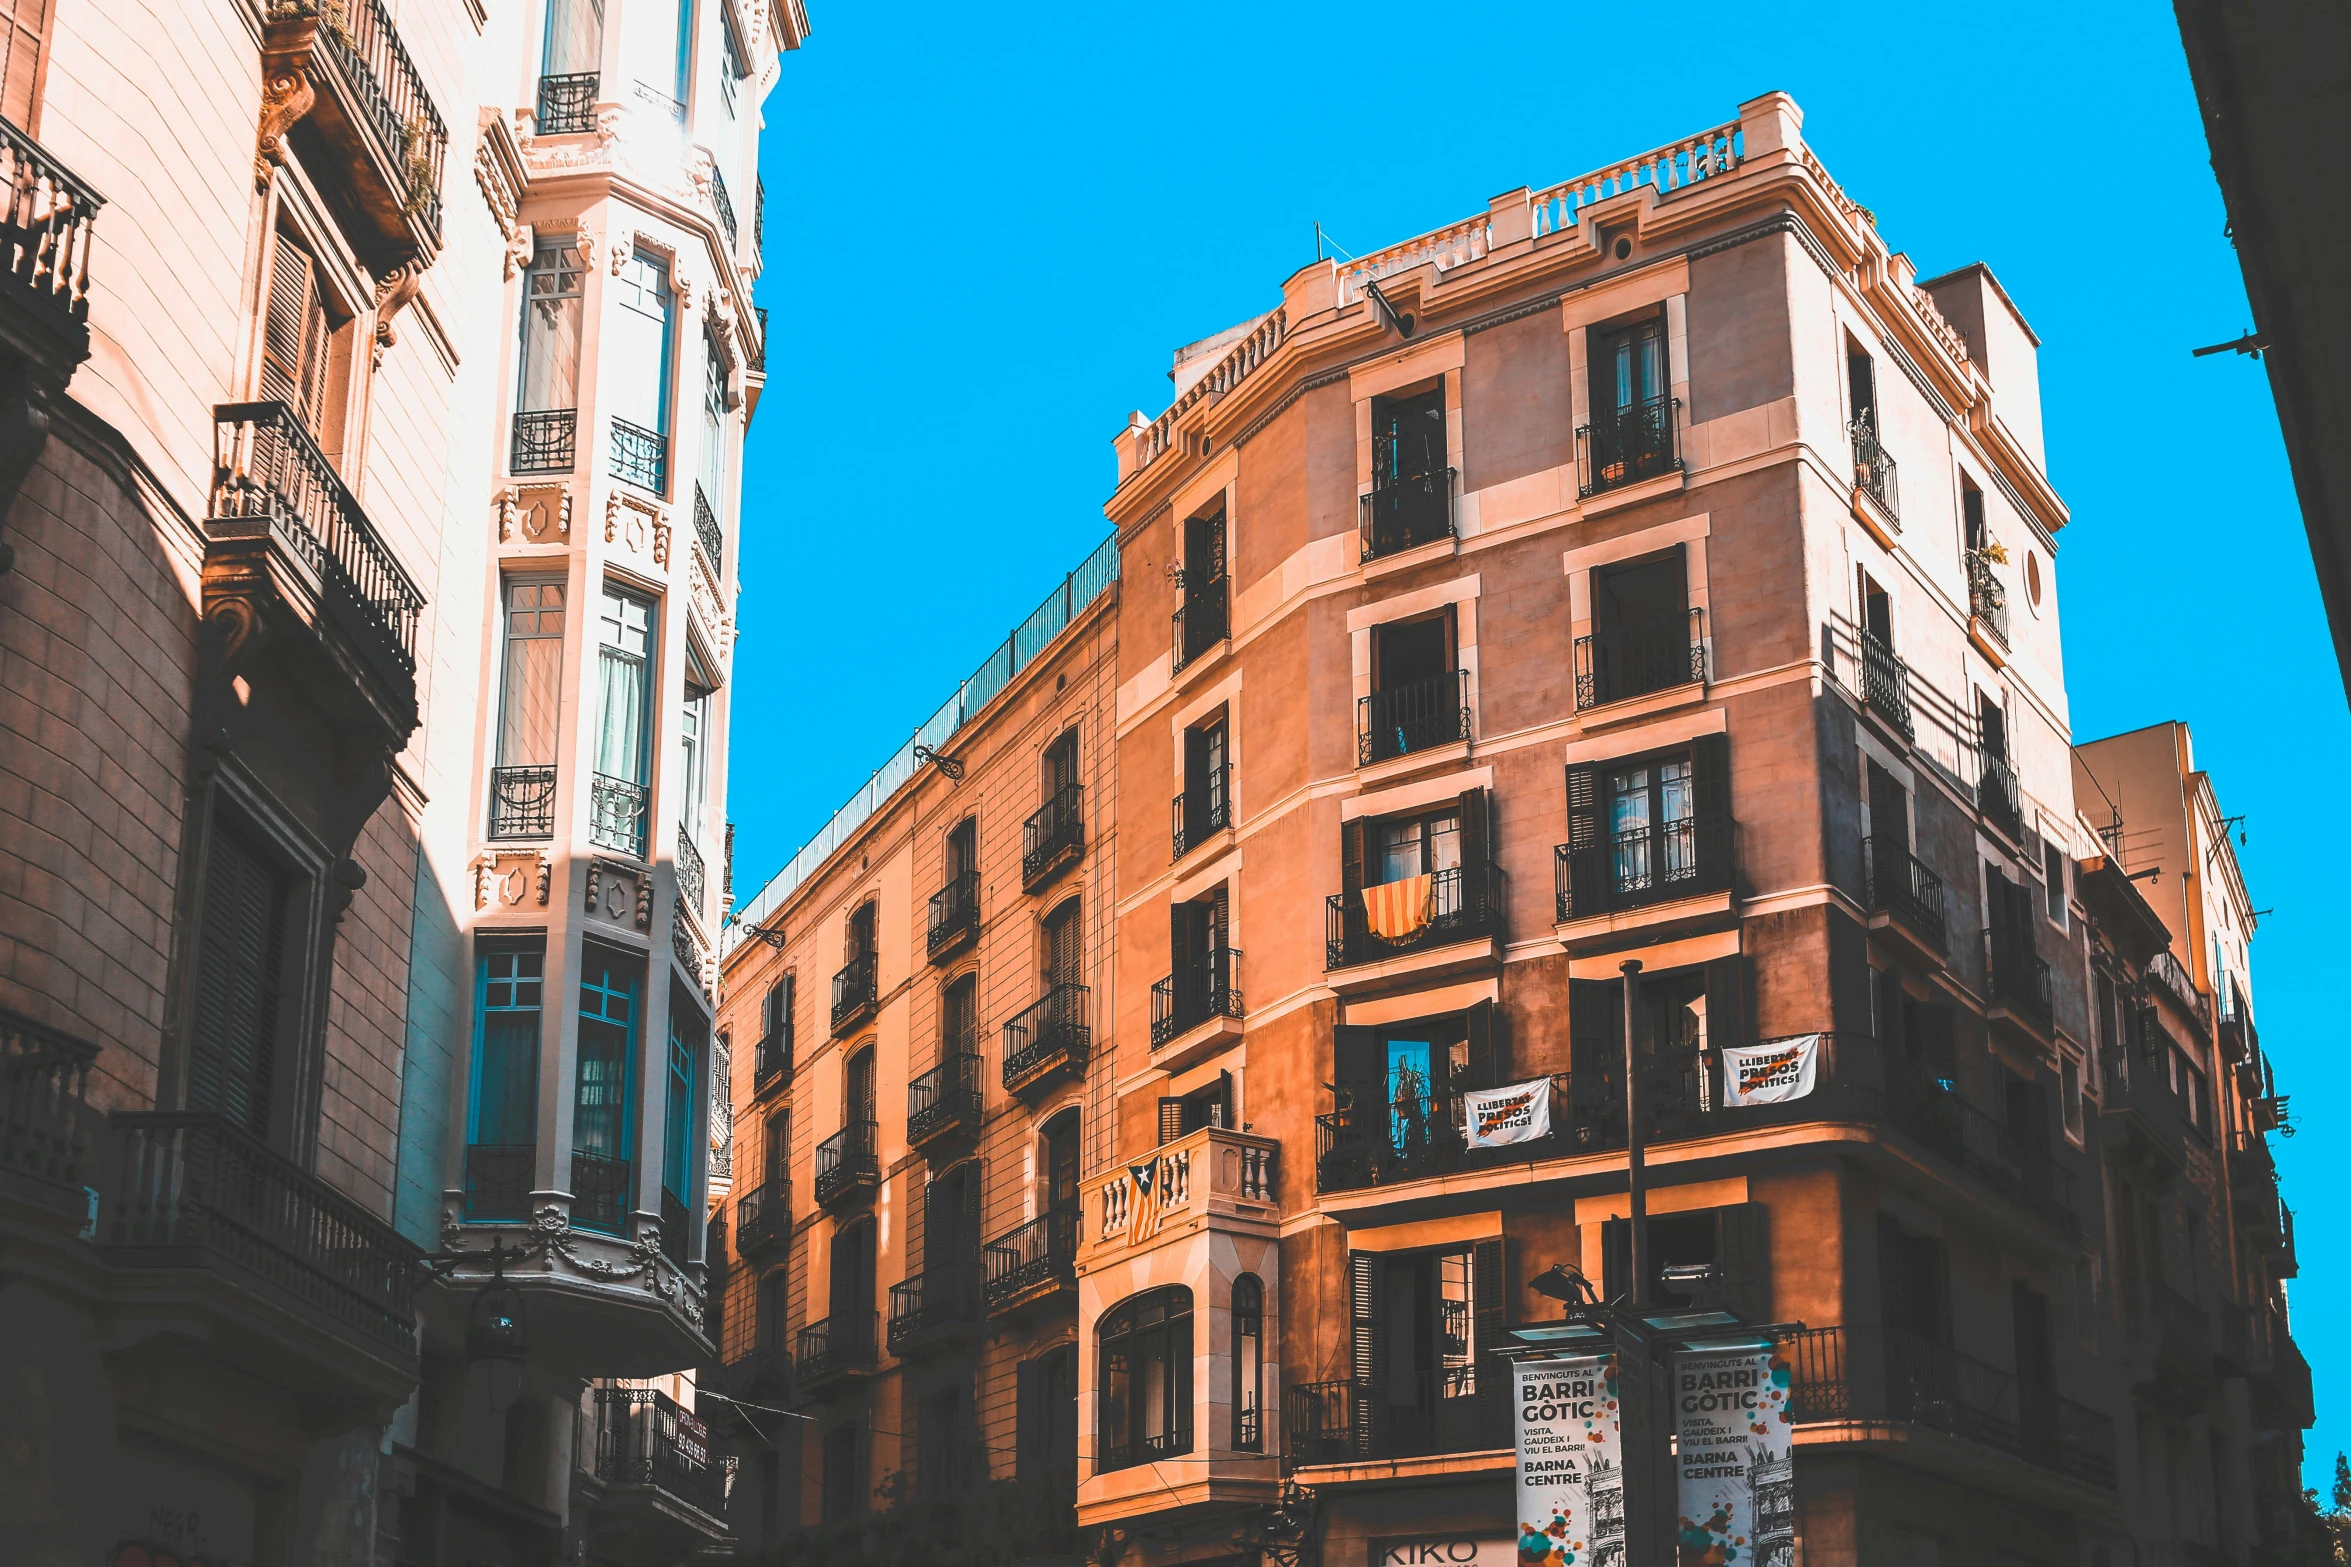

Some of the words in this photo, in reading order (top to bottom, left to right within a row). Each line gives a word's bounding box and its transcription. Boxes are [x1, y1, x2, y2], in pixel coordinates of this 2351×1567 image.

[1739, 1051, 1799, 1067] LLIBERTAT
[1740, 1061, 1799, 1079] PRESOS
[1477, 1095, 1531, 1110] LLIBERTAT
[1478, 1105, 1530, 1123] PRESOS
[1681, 1359, 1742, 1371] BENVINGUTS
[1745, 1358, 1757, 1366] AL
[1522, 1370, 1580, 1382] BENVINGUTS
[1582, 1369, 1594, 1377] AL
[1681, 1369, 1758, 1391] BARRI
[1522, 1380, 1594, 1401] BARRI
[1681, 1389, 1758, 1413] GÒTIC
[1522, 1400, 1594, 1422] GÒTIC
[1524, 1428, 1553, 1436] VISITA,
[1683, 1427, 1726, 1437] GAUDEIX
[1524, 1436, 1564, 1445] GAUDEIX
[1683, 1439, 1700, 1447] VIU
[1716, 1435, 1748, 1445] BARRI!
[1555, 1444, 1586, 1453] BARRI!
[1683, 1451, 1738, 1465] BARNA
[1524, 1459, 1576, 1472] BARNA
[1683, 1465, 1744, 1479] CENTRE
[1525, 1473, 1582, 1486] CENTRE
[1382, 1539, 1478, 1566] KIKO
